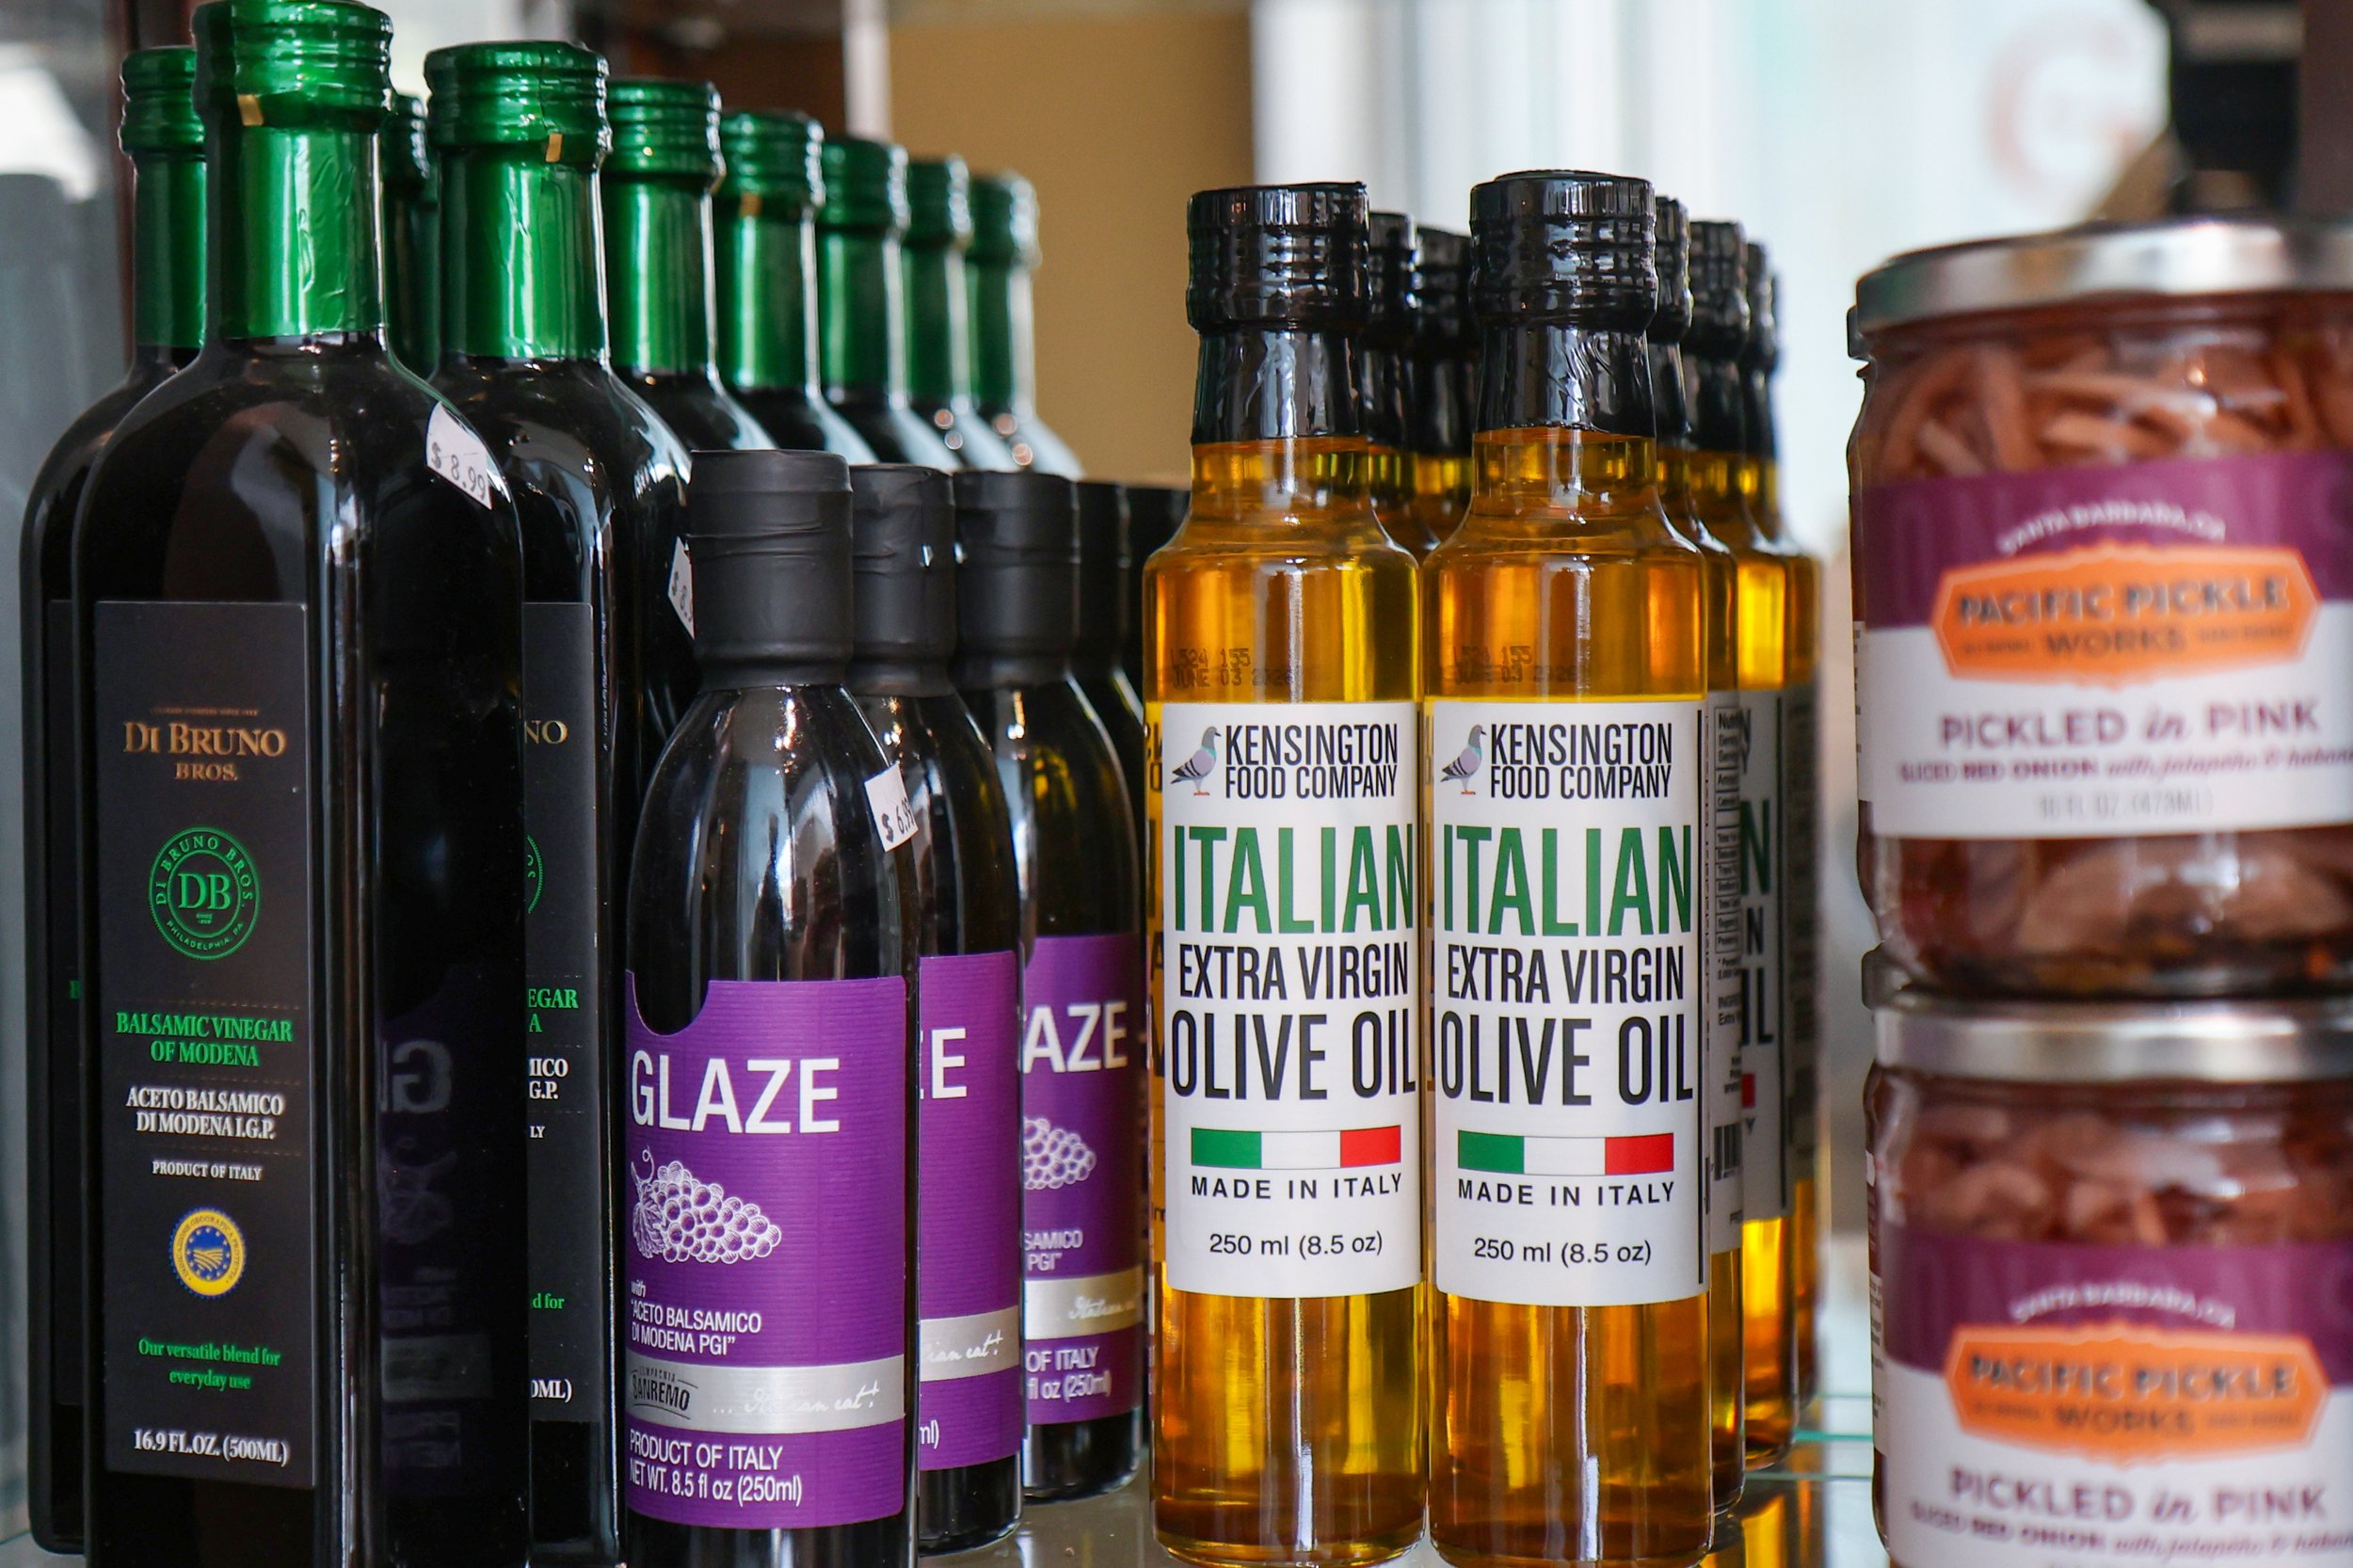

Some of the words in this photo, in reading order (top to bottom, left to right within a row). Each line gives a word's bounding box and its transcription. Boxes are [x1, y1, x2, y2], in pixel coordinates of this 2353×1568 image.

[431, 442, 440, 469] $
[451, 455, 486, 501] 8.99
[1961, 584, 2114, 628] PACIFIC
[2125, 574, 2289, 620] PICKLE
[2046, 625, 2186, 658] WORKS
[168, 722, 287, 757] BRUNO
[1939, 708, 2127, 749] PICKLED
[2143, 708, 2187, 741] in
[2206, 702, 2320, 738] PINK
[1225, 724, 1398, 765] KENSINGTON
[1491, 723, 1672, 765] KENSINGTON
[175, 761, 238, 780] BROS.
[1225, 766, 1286, 799] FOOD
[1296, 764, 1398, 799] COMPANY
[1491, 765, 1549, 799] FOOD
[1561, 764, 1672, 799] COMPANY
[881, 813, 893, 843] $
[160, 836, 219, 872] BRUNO
[178, 872, 232, 910] DB
[1174, 824, 1414, 934] ITALIAN
[1443, 824, 1691, 937] ITALIAN
[1178, 943, 1288, 1000] EXTRA
[1298, 941, 1408, 1000] VIRGIN
[1448, 944, 1551, 1003] EXTRA
[1561, 945, 1684, 1004] VIRGIN
[528, 988, 579, 1009] EGAR
[115, 1011, 209, 1038] BALSAMIC
[211, 1016, 294, 1042] VINEGAR
[1022, 1000, 1128, 1074] AZE
[150, 1041, 176, 1062] OF
[179, 1042, 261, 1067] MODENA
[1172, 1009, 1328, 1100] OLIVE
[1352, 1008, 1417, 1099] OIL
[1441, 1010, 1592, 1105] OLIVE
[1618, 1014, 1694, 1105] OIL
[125, 1085, 184, 1109] ACETO
[185, 1088, 285, 1116] BALSAMICO
[631, 1049, 840, 1133] GLAZE
[136, 1112, 157, 1132] DI
[158, 1112, 234, 1137] MODENA
[152, 1160, 208, 1177] PRODUCT
[210, 1164, 226, 1179] OF
[229, 1165, 263, 1181] ITALY
[1192, 1175, 1272, 1200] MADE
[1289, 1180, 1318, 1200] IN
[1334, 1173, 1401, 1198] ITALY
[1458, 1178, 1533, 1205] MADE
[1551, 1186, 1580, 1206] IN
[1598, 1181, 1674, 1206] ITALY
[1209, 1233, 1252, 1256] 250
[1260, 1235, 1289, 1256] ml
[1299, 1234, 1344, 1260] (8.5
[1352, 1231, 1383, 1256] oz)
[1474, 1238, 1513, 1260] 250
[1523, 1242, 1551, 1263] ml
[1561, 1242, 1609, 1268] (8.5
[1617, 1240, 1652, 1265] oz)
[545, 1293, 565, 1309] for
[632, 1321, 640, 1343] DI
[641, 1324, 696, 1353] MODENA
[665, 1306, 761, 1334] BALSAMICO
[138, 1338, 165, 1356] Our
[166, 1341, 221, 1361] versatile
[223, 1345, 259, 1364] blend
[261, 1348, 281, 1367] for
[1025, 1351, 1052, 1373] OF
[1056, 1347, 1099, 1370] ITALY
[169, 1368, 227, 1391] everyday
[230, 1375, 251, 1390] use
[632, 1372, 691, 1412] SANREMO
[1969, 1353, 2123, 1401] PACIFIC
[2134, 1362, 2299, 1403] PICKLE
[2055, 1402, 2197, 1437] WORKS
[134, 1430, 166, 1452] 16.9
[222, 1434, 289, 1466] (500ML)
[630, 1428, 692, 1466] PRODUCT
[696, 1443, 723, 1468] OF
[728, 1445, 783, 1471] ITALY
[630, 1457, 646, 1487] NET
[647, 1464, 668, 1494] WT.
[672, 1469, 695, 1497] 8.5
[698, 1472, 707, 1499] fl
[712, 1480, 732, 1501] oz
[737, 1474, 803, 1508] (250ml)
[1951, 1466, 2137, 1522] PICKLED
[2212, 1483, 2329, 1522] PINK
